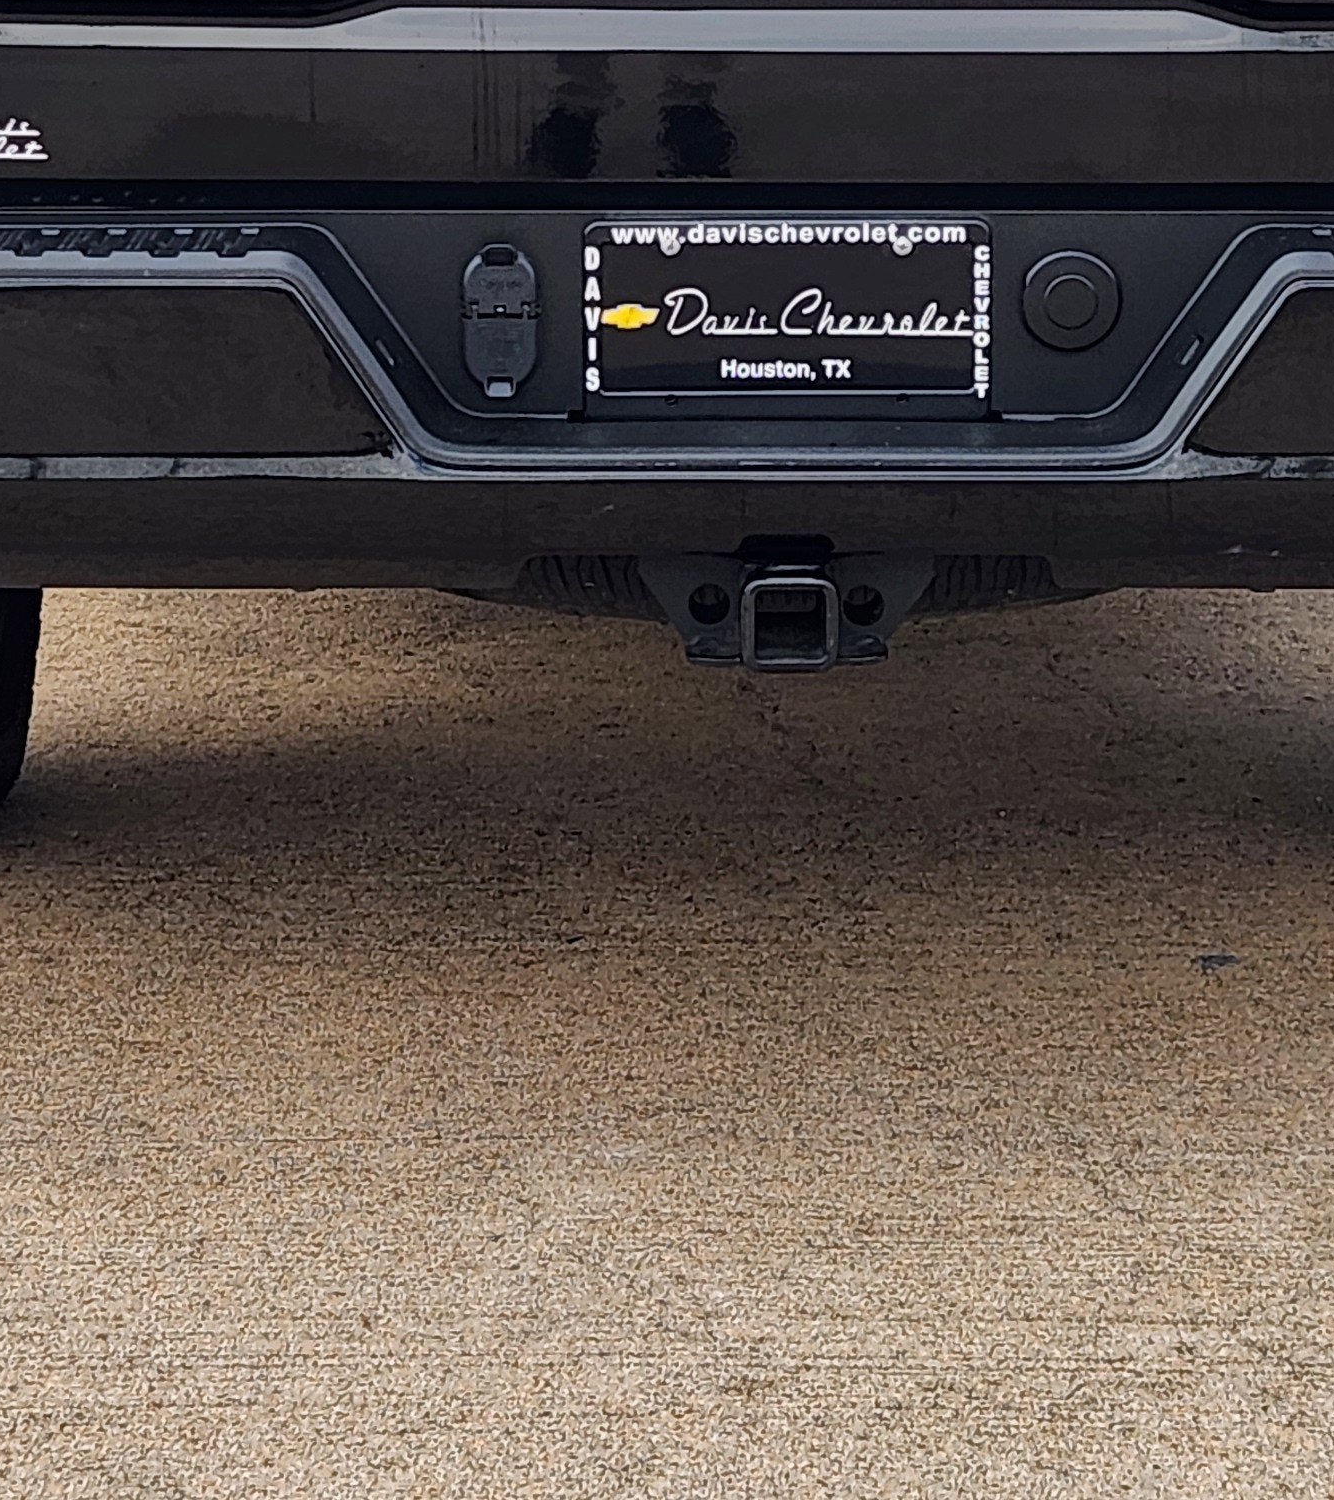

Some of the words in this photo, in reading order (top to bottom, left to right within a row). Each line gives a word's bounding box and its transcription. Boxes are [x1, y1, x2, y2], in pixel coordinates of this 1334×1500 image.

[610, 222, 967, 245] www.davischevroletcom
[584, 246, 601, 392] DAVIS
[664, 287, 778, 336] Davis
[780, 287, 973, 337] Chevrolet
[973, 244, 991, 399] CHEVROLET
[720, 358, 817, 381] Houston,
[821, 359, 851, 379] TX
